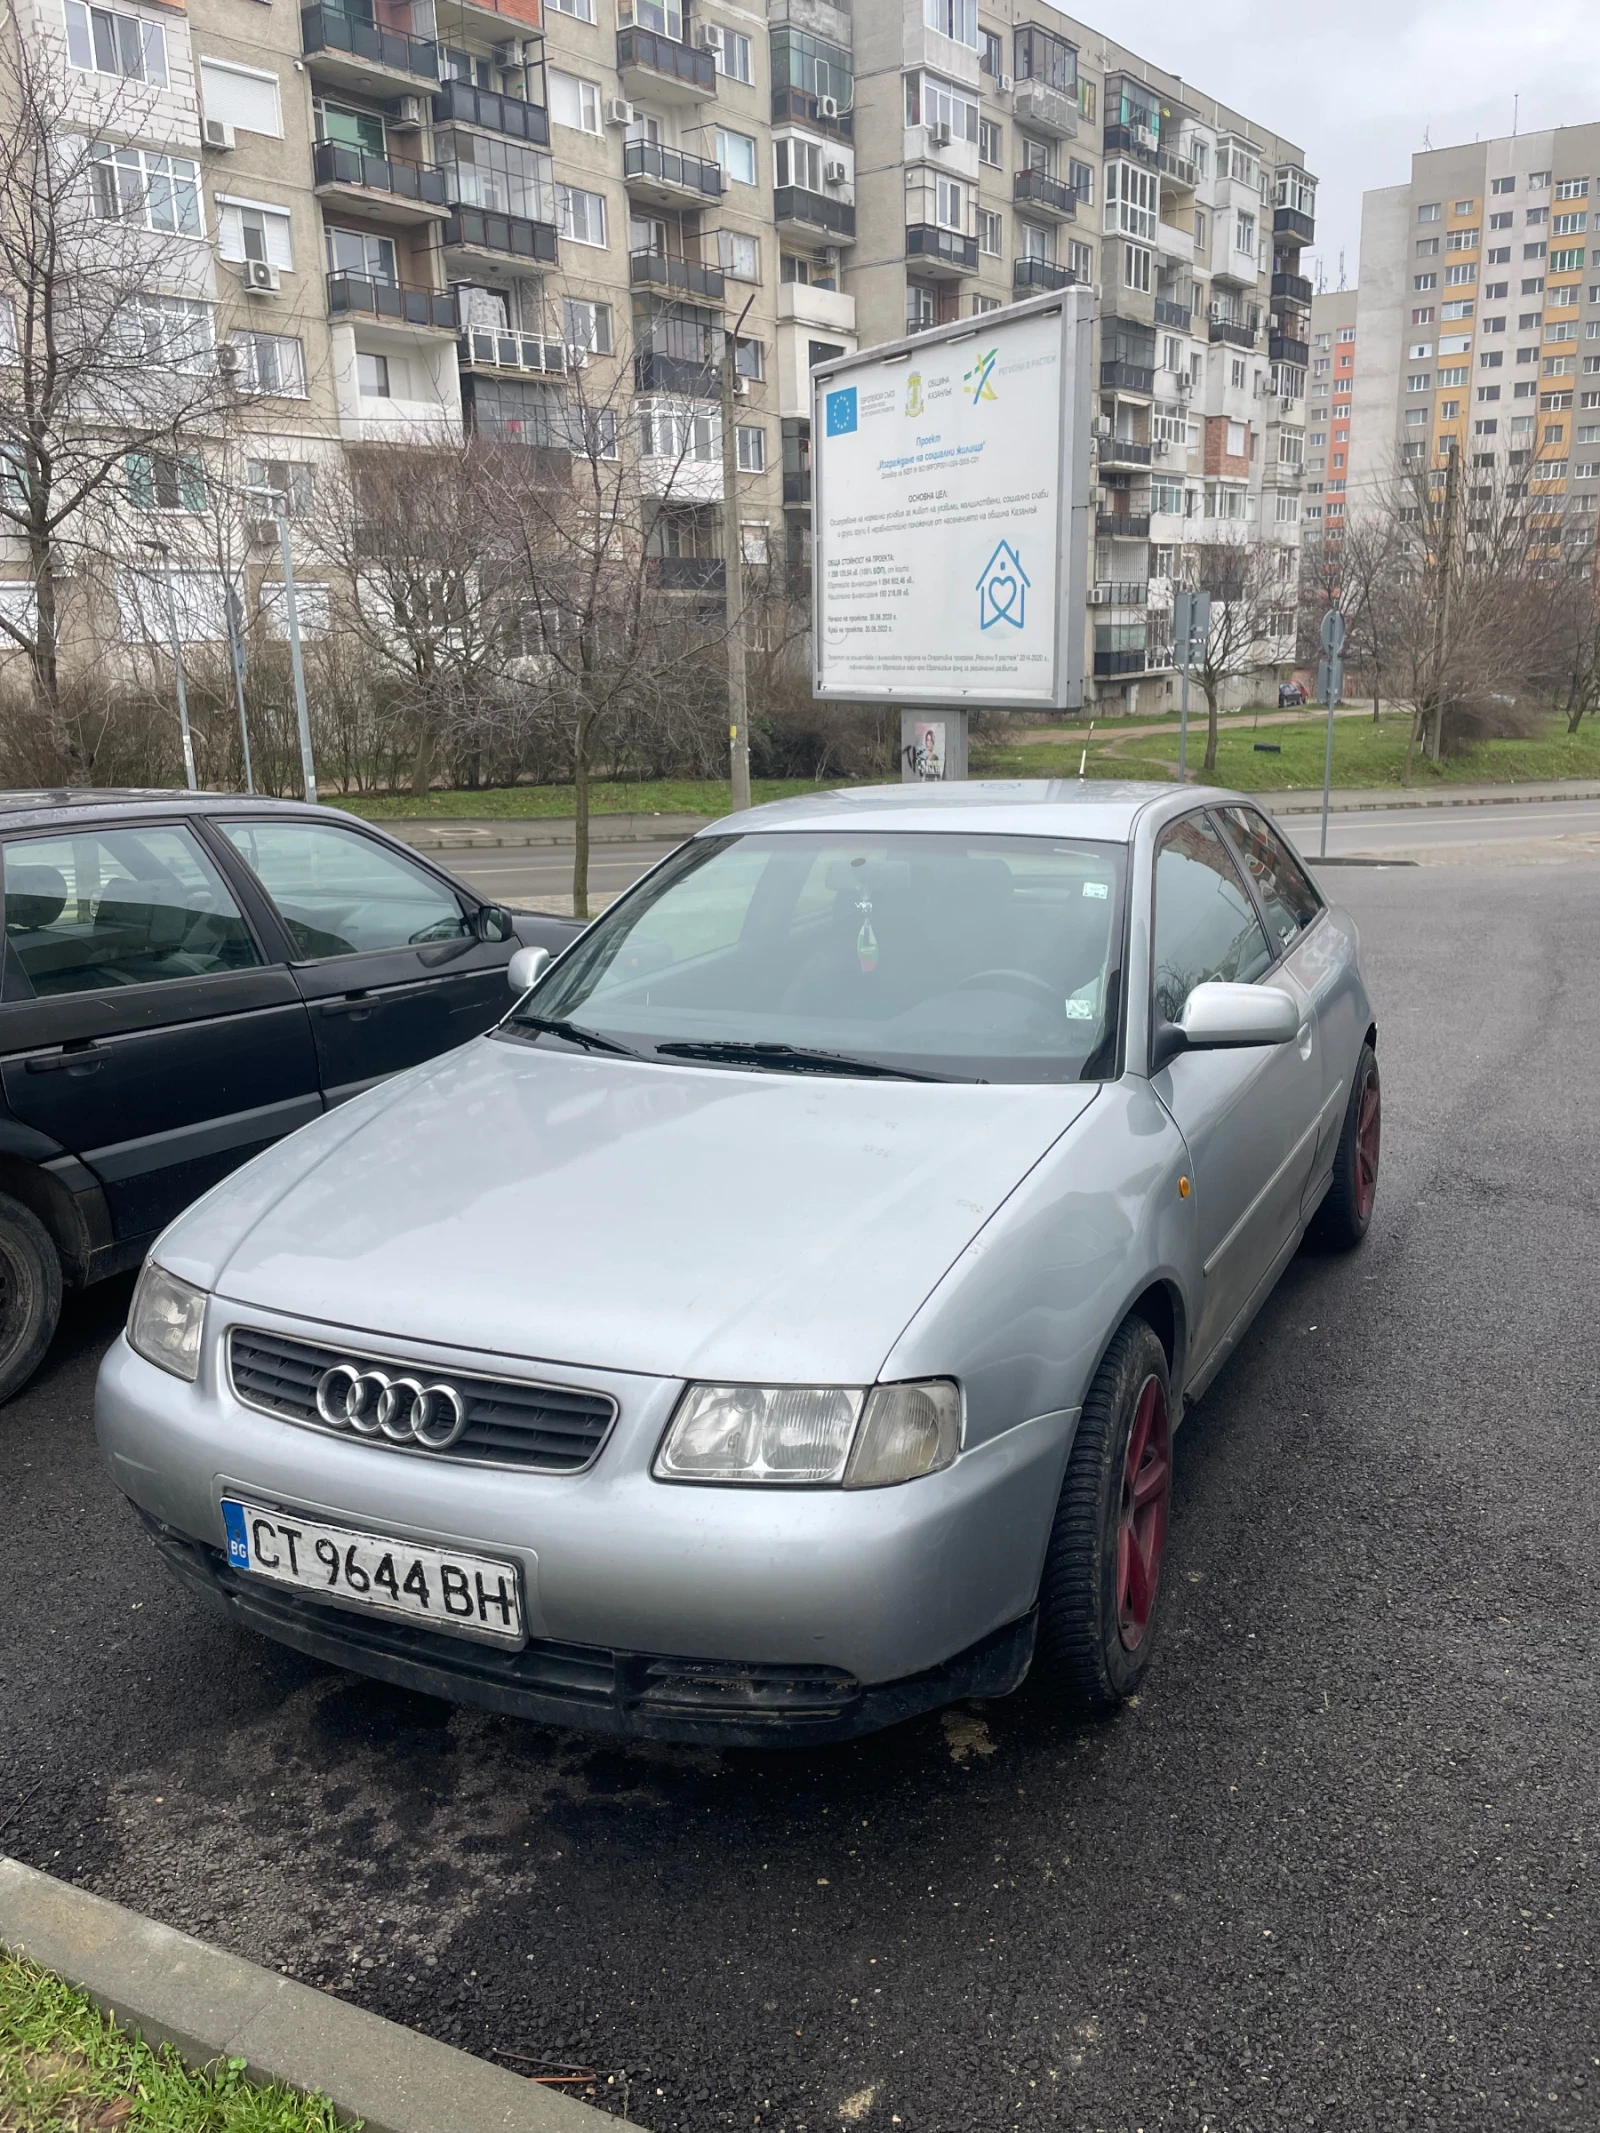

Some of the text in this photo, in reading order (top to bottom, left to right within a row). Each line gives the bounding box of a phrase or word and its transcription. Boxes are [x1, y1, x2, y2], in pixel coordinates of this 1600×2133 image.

[928, 376, 950, 388] ОБЩИНА
[927, 388, 953, 400] КАЗАНЛЪК
[916, 434, 941, 447] Проект
[916, 454, 923, 462] на
[925, 449, 955, 461] социални
[908, 490, 948, 503] ОСНОВНА ЦЕЛ:
[912, 506, 929, 516] живот
[930, 505, 937, 513] на
[1002, 493, 1030, 504] социално
[1031, 488, 1049, 500] слаби
[934, 518, 942, 526] от
[944, 514, 978, 525] населението
[979, 512, 986, 520] на
[988, 509, 1009, 520] община
[1010, 505, 1038, 516] Казанлък
[842, 556, 864, 566] СТОЙНОСТ
[865, 555, 871, 563] НА
[230, 1540, 247, 1559] BG
[252, 1518, 512, 1626] CT 9644 BH
